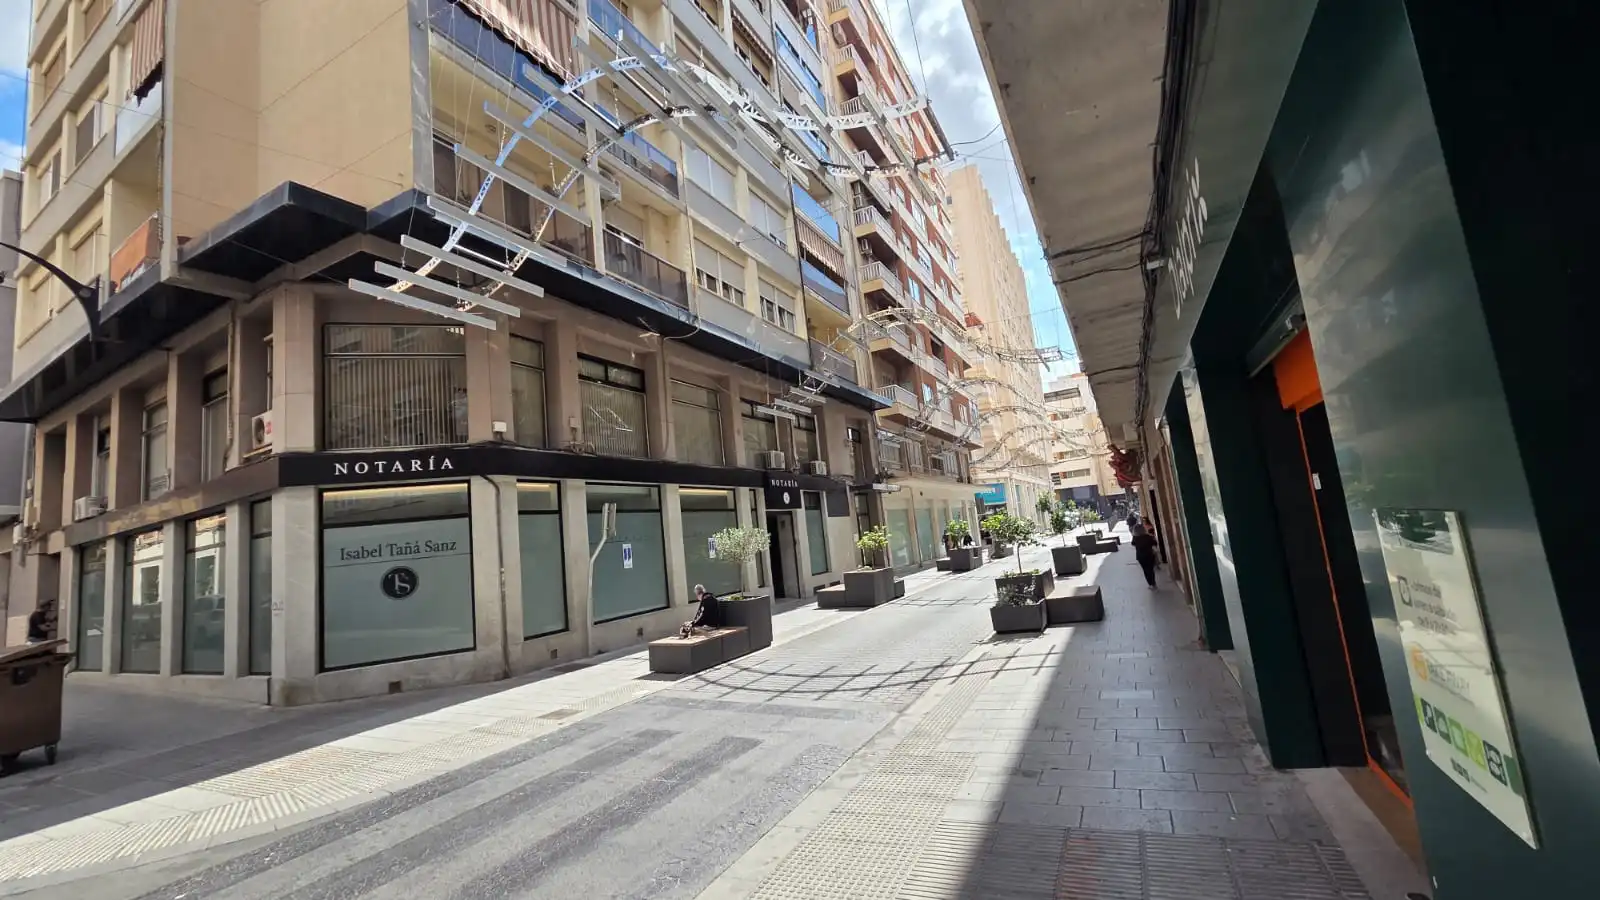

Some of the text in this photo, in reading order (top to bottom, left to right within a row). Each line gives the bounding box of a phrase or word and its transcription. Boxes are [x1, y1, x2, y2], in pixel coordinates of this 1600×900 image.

[334, 455, 454, 476] NOTARÍA
[771, 479, 799, 488] NOTARÍA
[340, 539, 457, 561] Isabel Tañá Sanz
